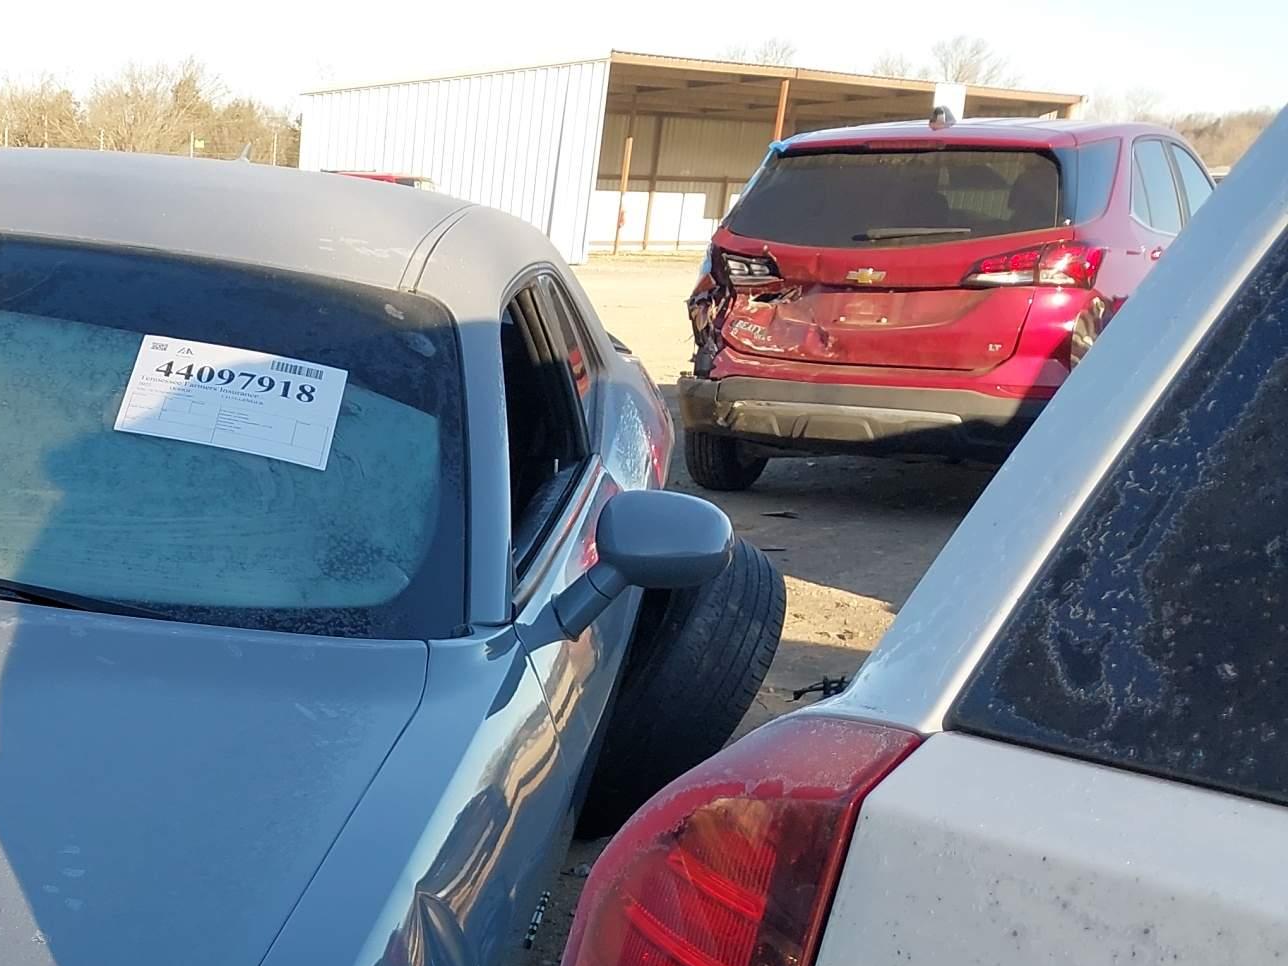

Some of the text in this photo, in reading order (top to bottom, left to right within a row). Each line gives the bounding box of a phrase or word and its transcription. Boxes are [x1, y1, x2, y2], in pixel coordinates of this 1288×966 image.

[988, 343, 1002, 351] LT
[155, 361, 316, 402] 44097918
[184, 381, 218, 391] Farmers
[219, 386, 260, 398] Insurance
